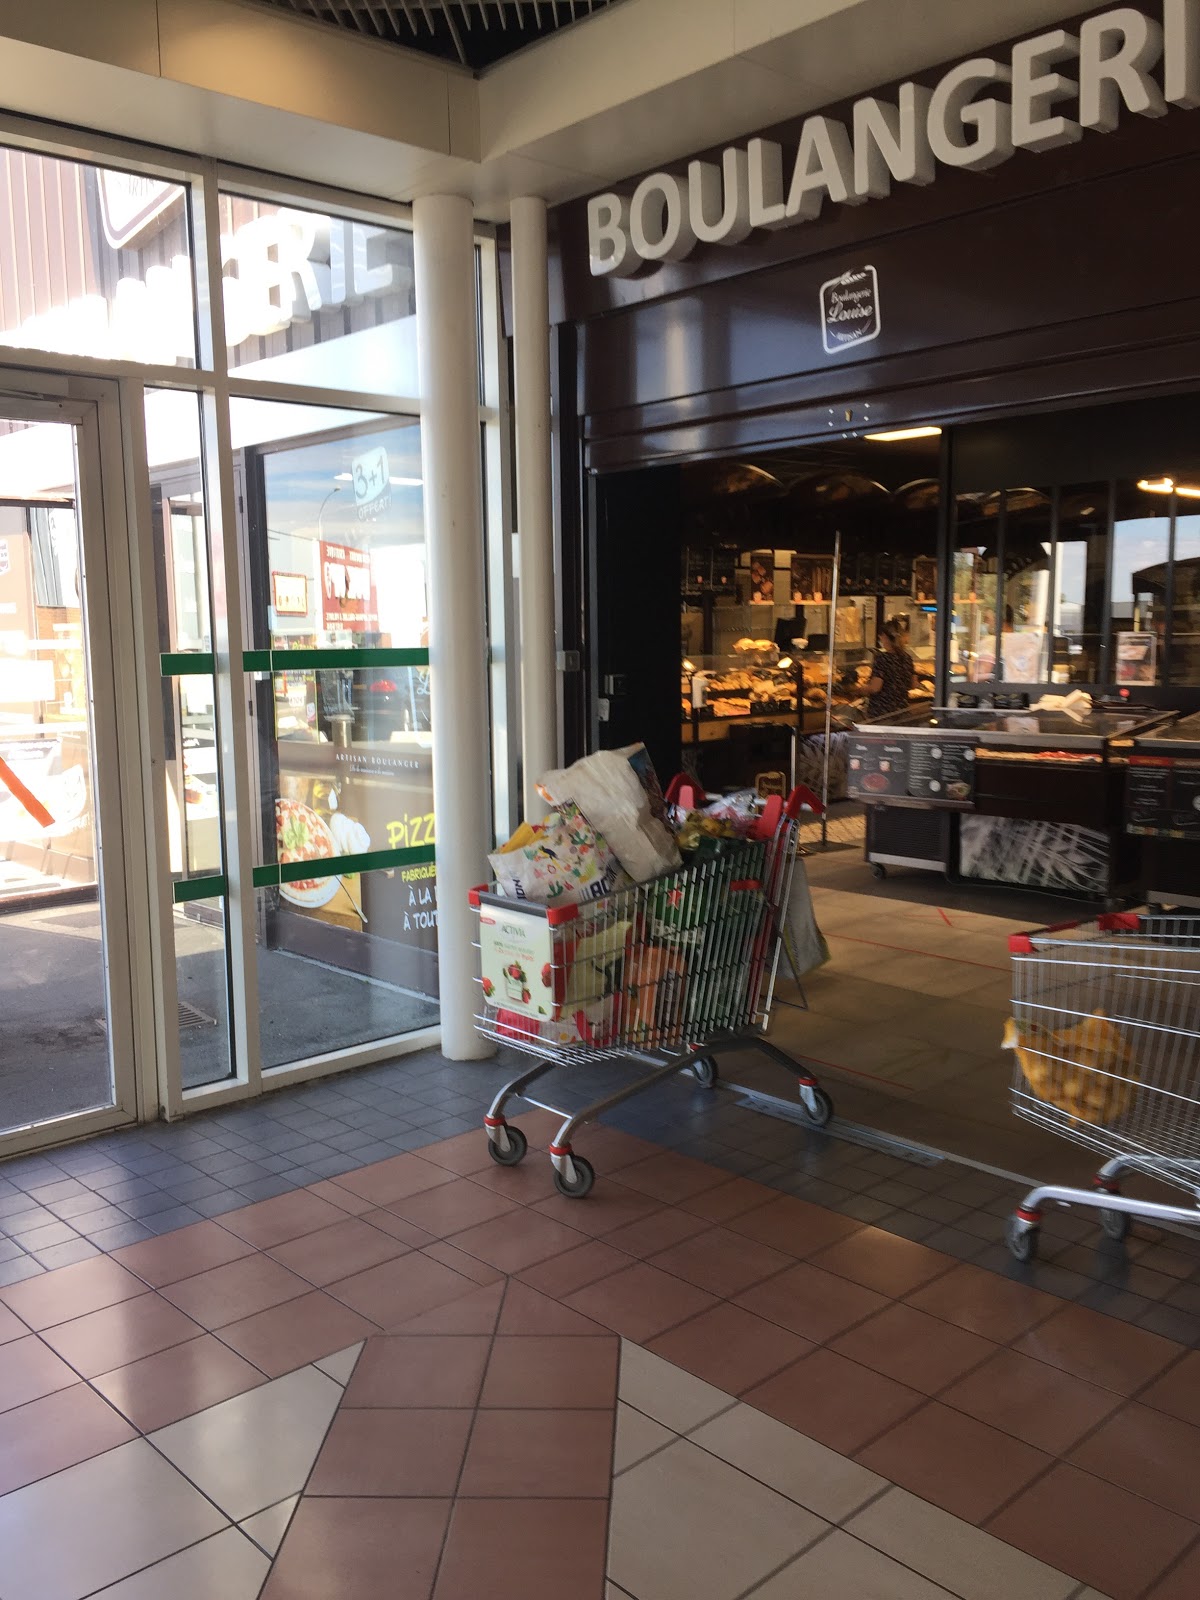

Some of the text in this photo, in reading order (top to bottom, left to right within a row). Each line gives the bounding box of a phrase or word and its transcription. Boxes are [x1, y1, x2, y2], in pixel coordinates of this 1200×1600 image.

[587, 0, 1200, 278] BOULANGERI
[826, 301, 873, 324] Louise
[355, 455, 386, 499] 3+1
[335, 753, 420, 769] ARTISAN BOULANGER
[407, 884, 433, 907] À LA
[403, 910, 412, 932] À
[501, 925, 527, 938] ACTIVIA
